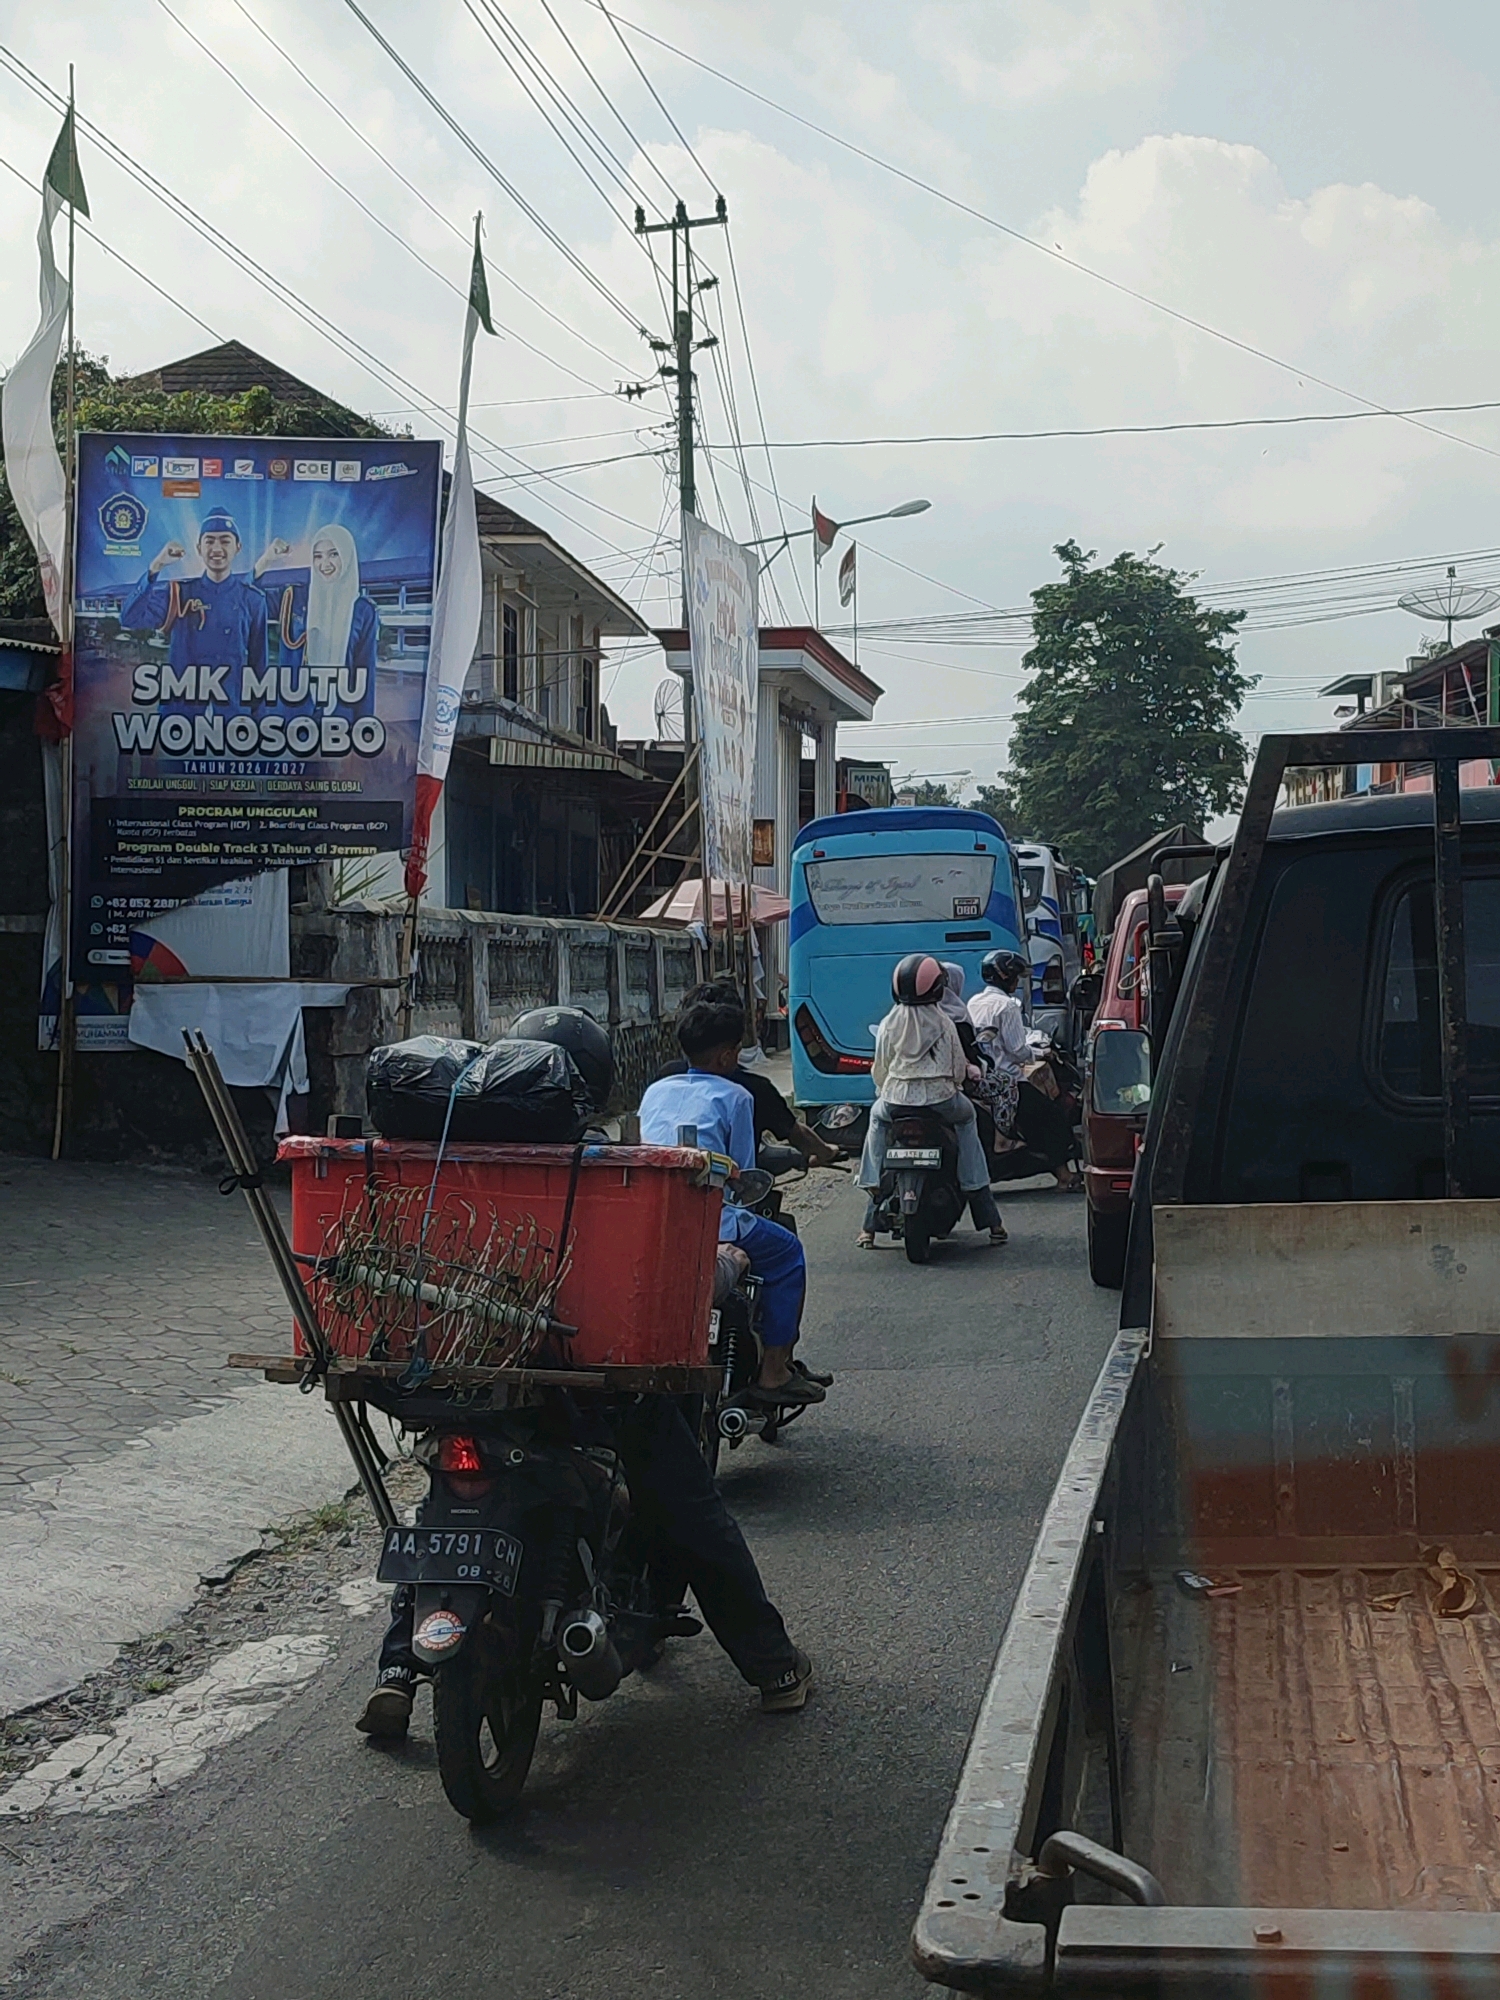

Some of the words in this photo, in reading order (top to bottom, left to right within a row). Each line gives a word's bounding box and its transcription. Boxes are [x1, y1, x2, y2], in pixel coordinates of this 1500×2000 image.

[296, 463, 328, 474] COE
[133, 664, 230, 702] SMK
[241, 666, 368, 704] MUTU
[113, 713, 386, 754] WONOSOBO
[184, 760, 225, 774] TAHUN
[230, 762, 261, 774] 2026
[274, 762, 306, 775] 2027
[854, 774, 885, 782] MINI
[128, 778, 164, 790] SEKOLAH
[165, 778, 198, 790] UNGGUL
[210, 780, 229, 792] SIAP
[230, 780, 256, 792] KERJA
[267, 780, 303, 792] BERDAYA
[304, 781, 330, 792] SAING
[330, 782, 362, 793] GLOBAL
[178, 806, 244, 817] PROGRAM
[246, 807, 318, 818] UNGGULAN
[172, 820, 193, 828] Class
[194, 820, 228, 830] Program
[269, 821, 306, 830] Boarding
[307, 822, 329, 830] Class
[330, 822, 364, 832] Program
[118, 842, 172, 854] Program
[175, 843, 220, 853] Double
[223, 844, 258, 854] Track
[260, 844, 268, 854] 3
[271, 843, 311, 854] Tahun
[314, 843, 328, 854] di
[330, 845, 378, 855] Jerman
[388, 1532, 416, 1555] AA
[428, 1534, 482, 1556] 5791
[457, 1565, 481, 1578] 08
